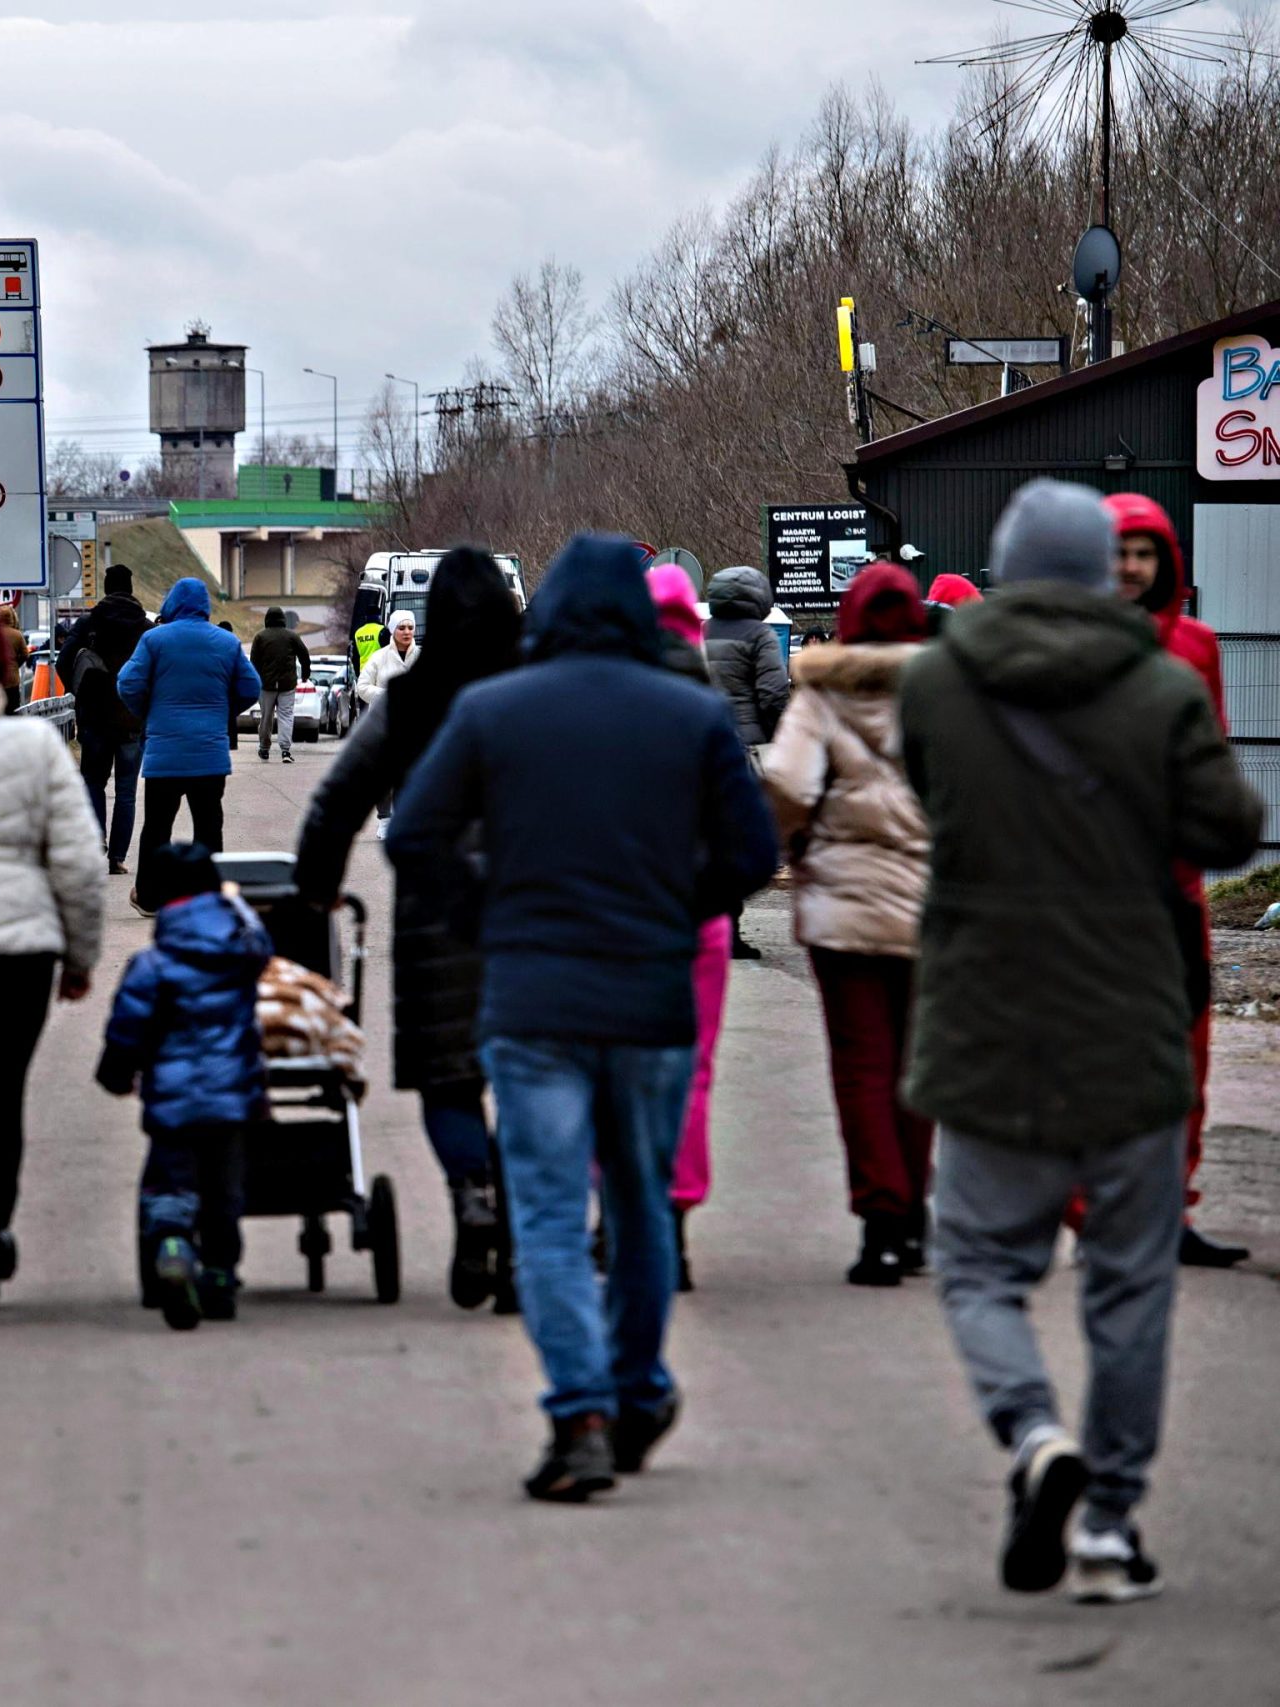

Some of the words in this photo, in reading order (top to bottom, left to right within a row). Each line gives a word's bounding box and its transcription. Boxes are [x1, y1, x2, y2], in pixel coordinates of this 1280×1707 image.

[772, 510, 825, 522] CENTRUM
[827, 509, 867, 520] LOGIST
[782, 528, 816, 536] MAGAZYN
[780, 557, 819, 565] PUBLICZNY
[783, 571, 817, 579] MAGAZYN
